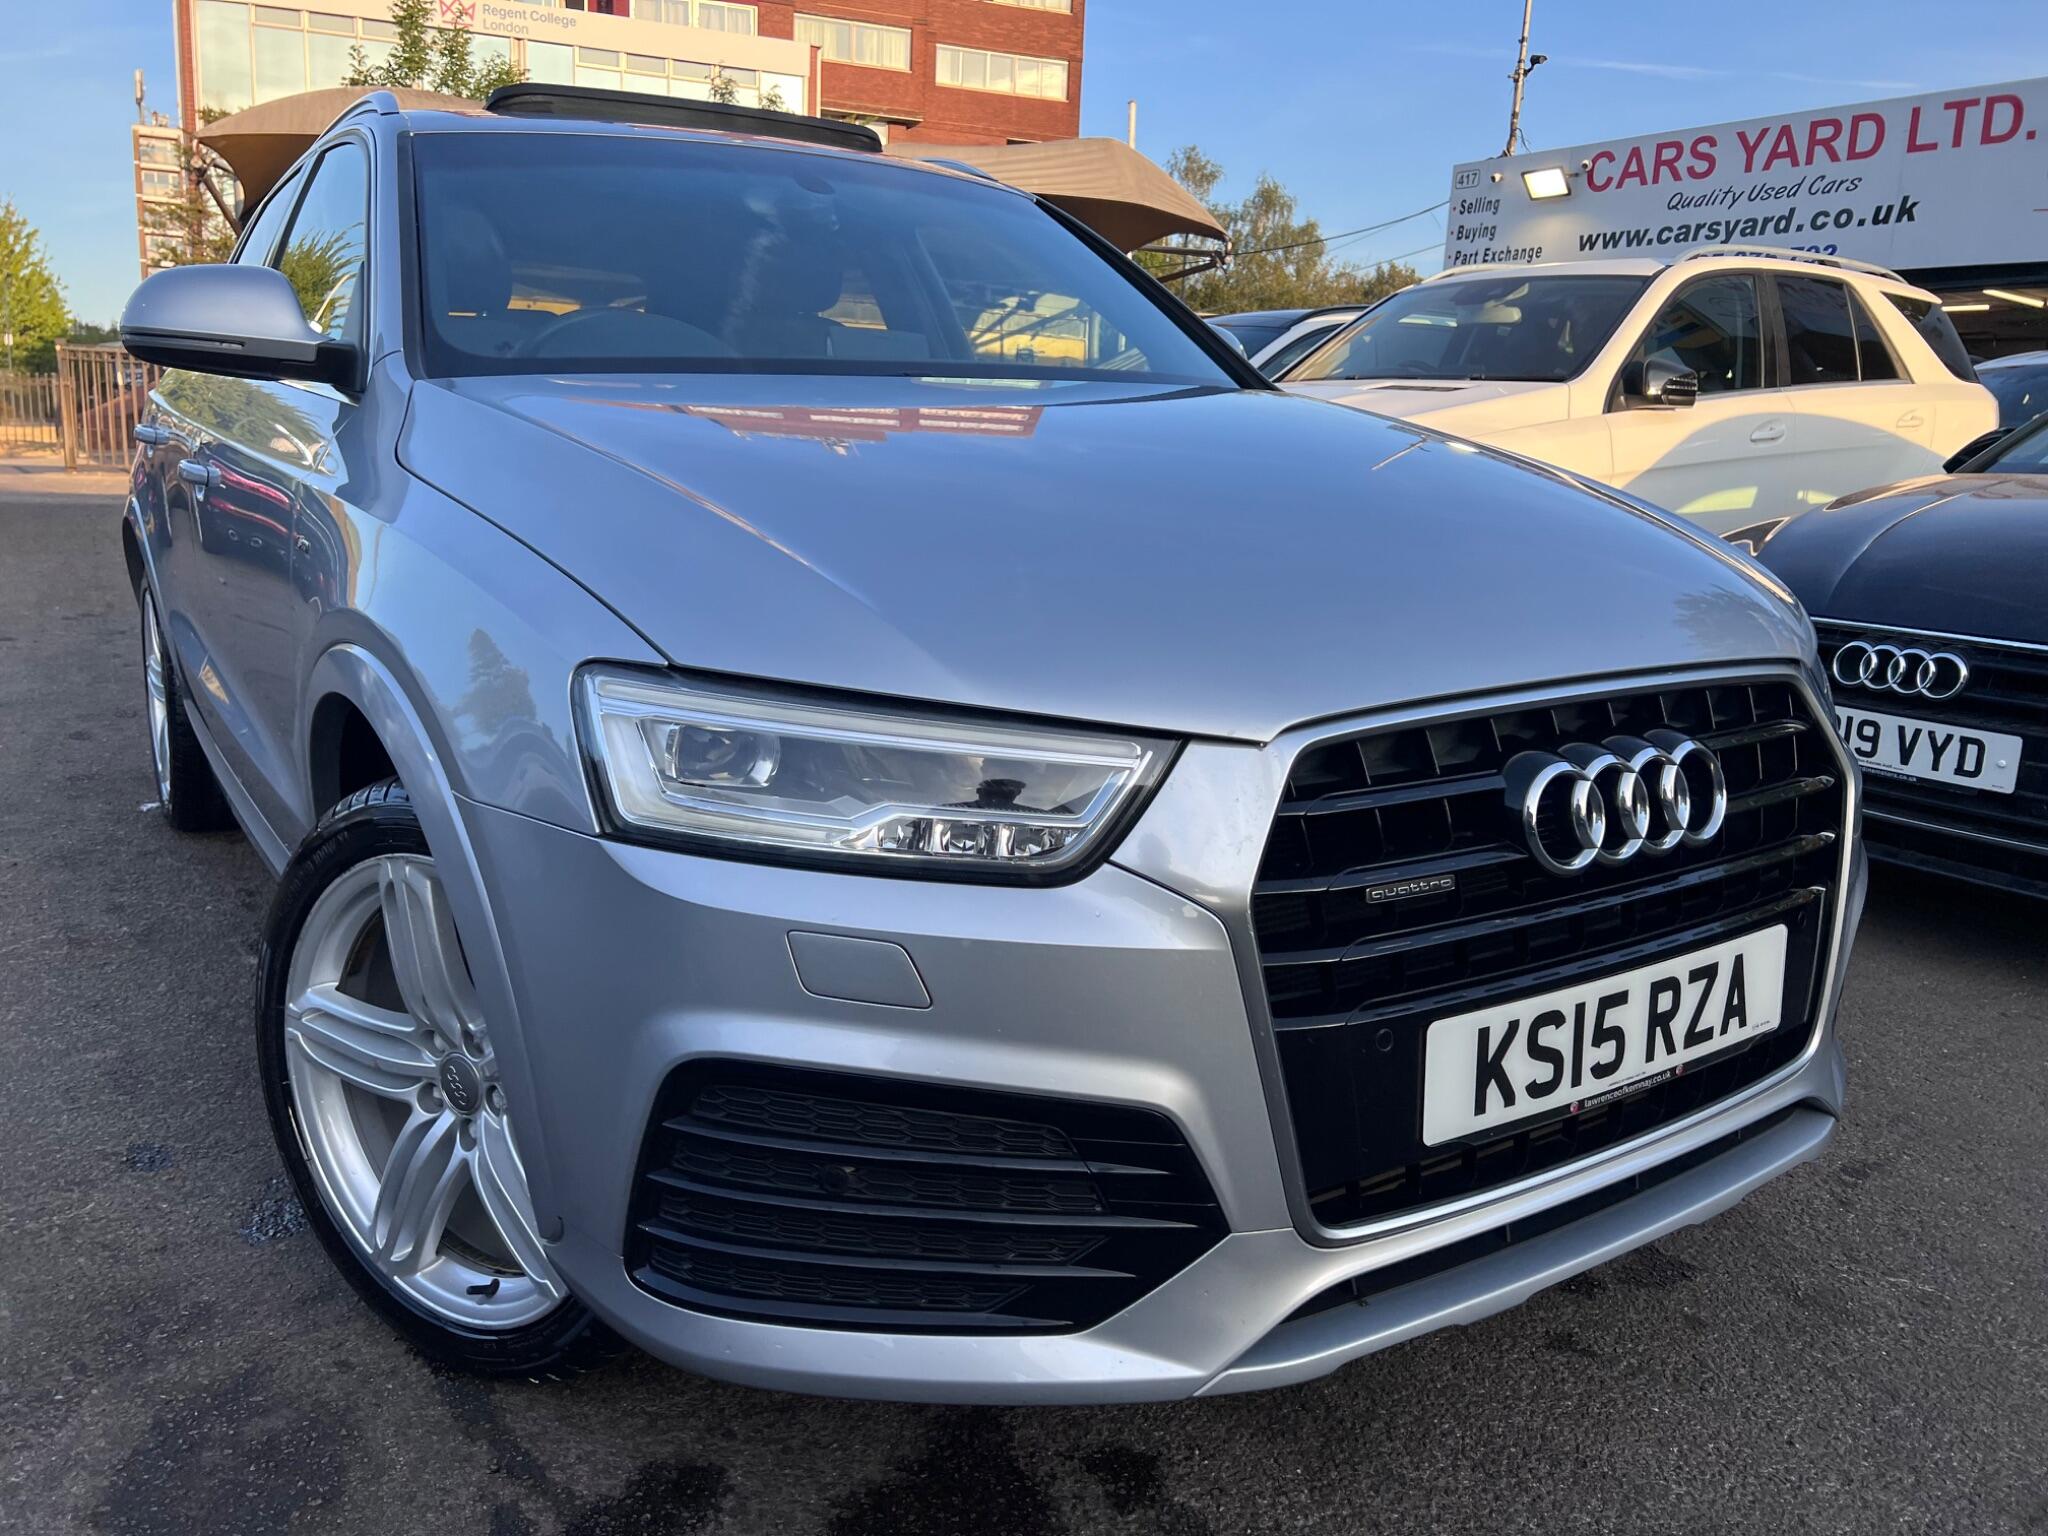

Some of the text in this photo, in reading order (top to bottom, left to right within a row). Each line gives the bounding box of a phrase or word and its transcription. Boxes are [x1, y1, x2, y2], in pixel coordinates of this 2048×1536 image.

[482, 3, 577, 28] Regent College
[482, 18, 529, 35] London
[1587, 93, 2038, 192] CARS YARD LTD.
[1457, 172, 1478, 186] 417
[1667, 175, 1863, 211] Quality Used Cars
[1459, 197, 1500, 215] Selling
[1456, 222, 1497, 243] Buying
[1578, 195, 1920, 252] www.carsyard.co.uk
[1453, 245, 1542, 265] Part Exchange
[1836, 714, 1986, 779] 19 VYD
[1371, 879, 1452, 899] quattro
[1474, 953, 1748, 1117] KS15 RZA
